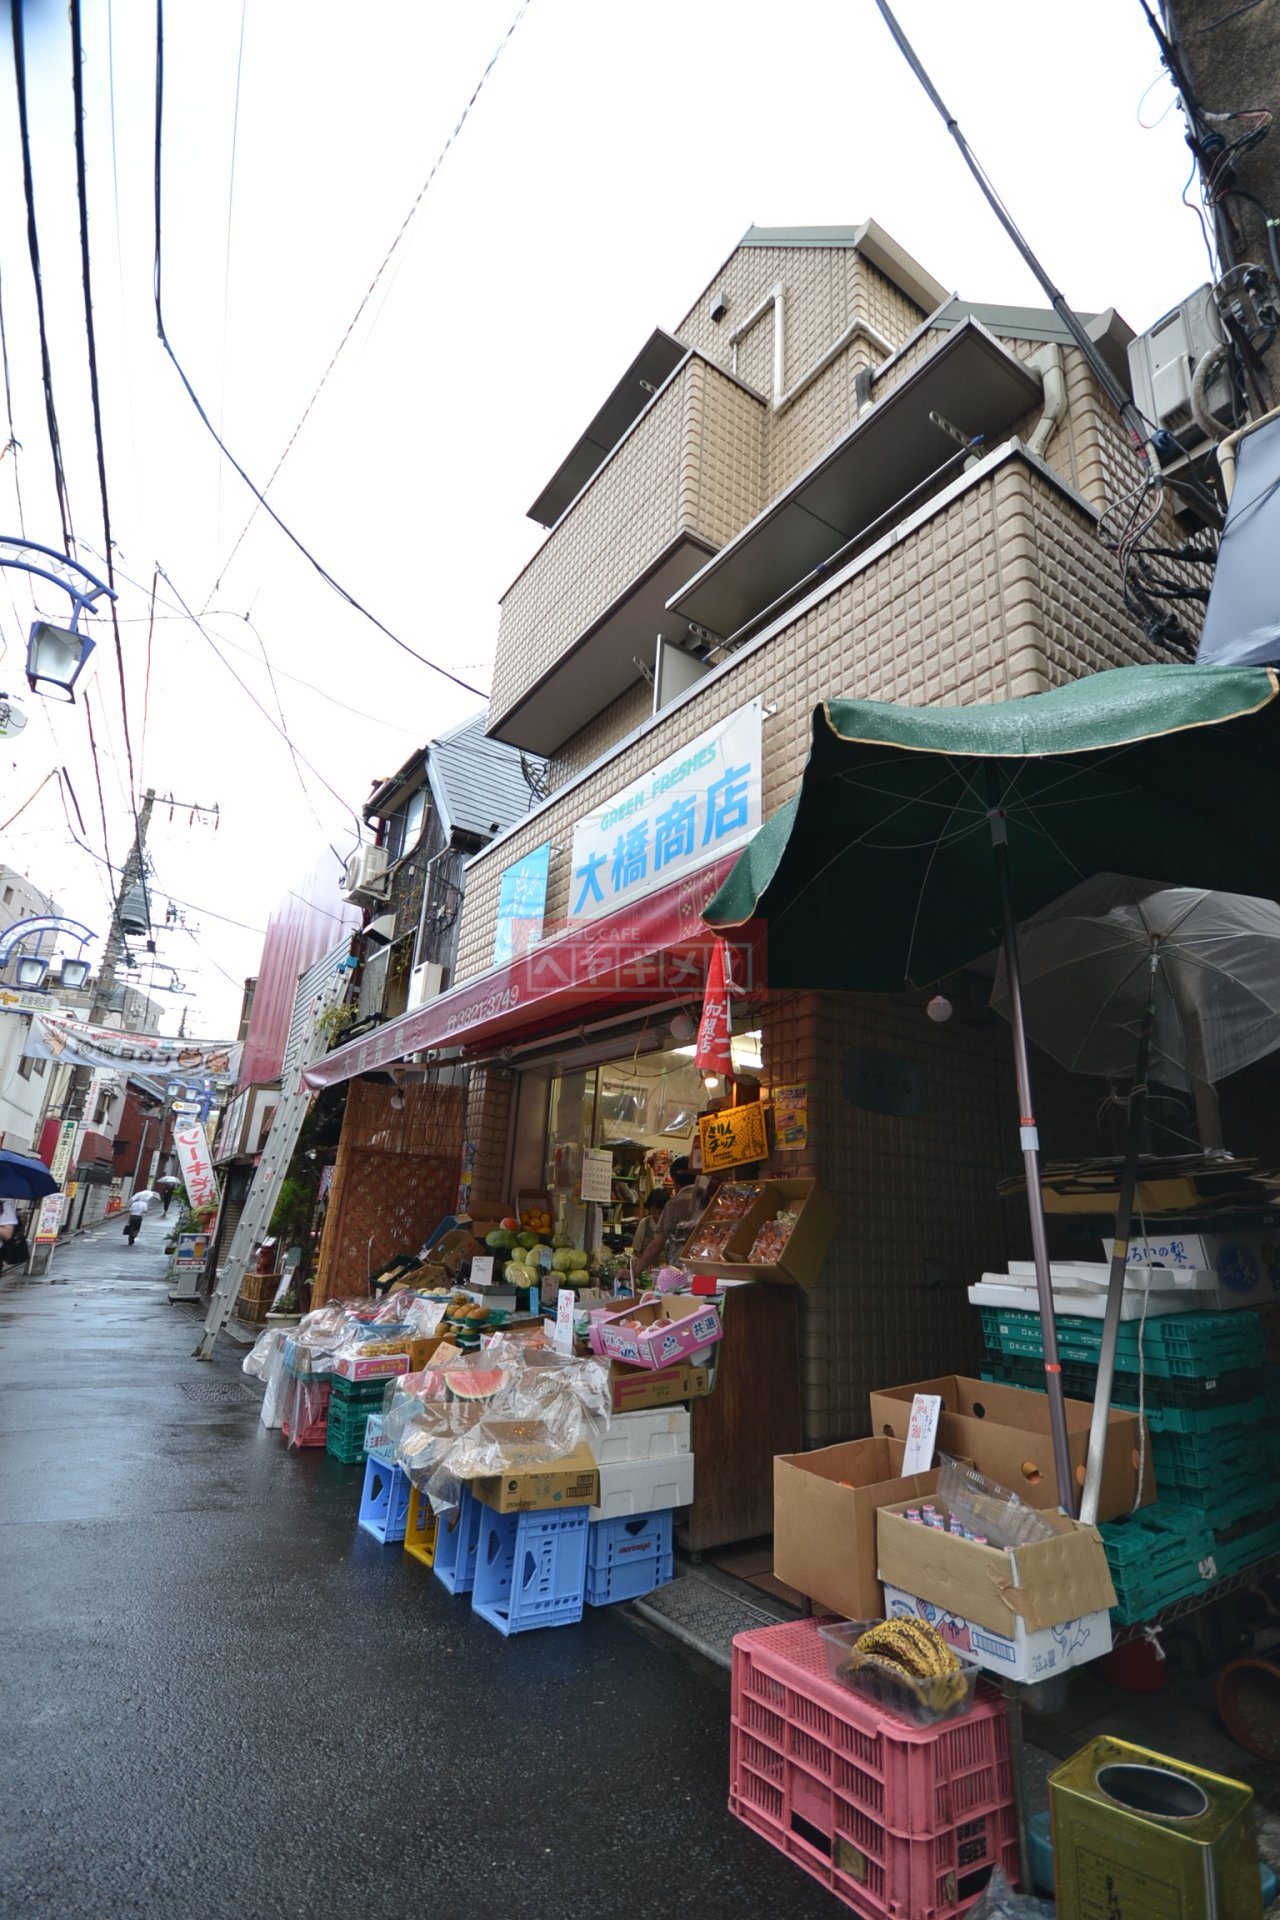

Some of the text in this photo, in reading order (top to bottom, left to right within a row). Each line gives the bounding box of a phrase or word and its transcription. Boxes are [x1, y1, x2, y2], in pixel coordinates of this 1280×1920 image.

[600, 741, 717, 832] GREEN FRESHES
[573, 762, 752, 915] 大橋商店
[692, 1316, 718, 1336] 共選
